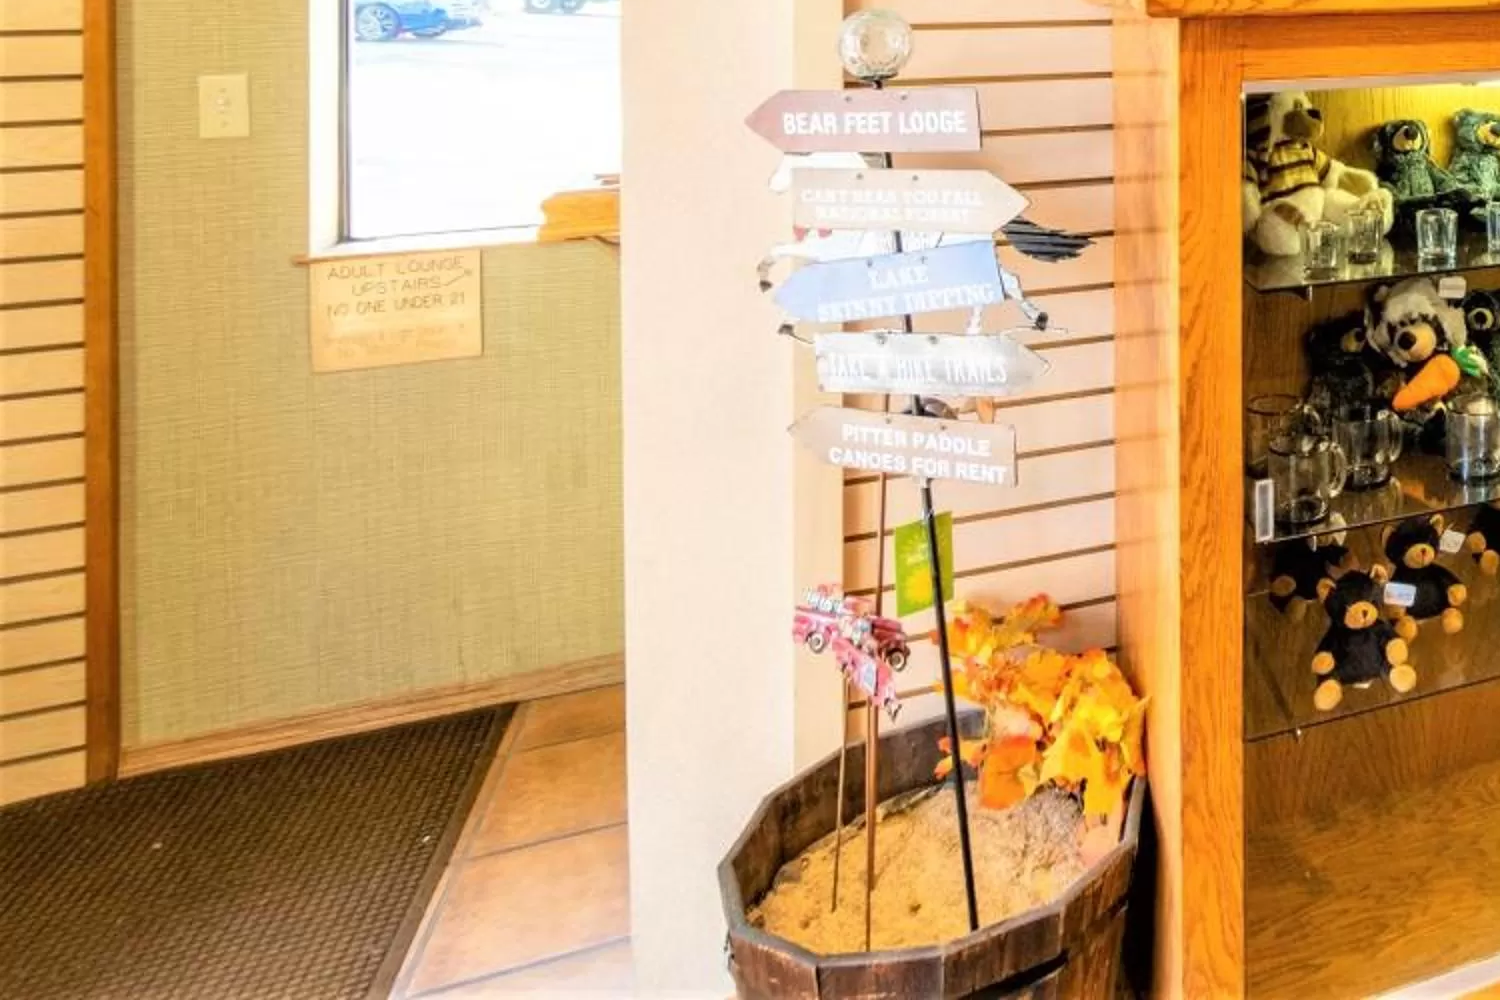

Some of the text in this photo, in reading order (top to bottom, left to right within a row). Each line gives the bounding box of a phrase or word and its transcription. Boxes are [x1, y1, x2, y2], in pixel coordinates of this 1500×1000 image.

[782, 109, 967, 136] BEAR FEET LODGE
[902, 190, 938, 206] YOU
[327, 263, 385, 281] ADULT
[351, 275, 442, 296] UPSTAIRS
[867, 265, 929, 290] LAKE
[327, 291, 465, 318] NO ONE UNDER 21
[944, 355, 1009, 385] TRAILS
[841, 423, 991, 457] PITTER PADDLE
[828, 447, 1008, 486] CANOES FOR RENT
